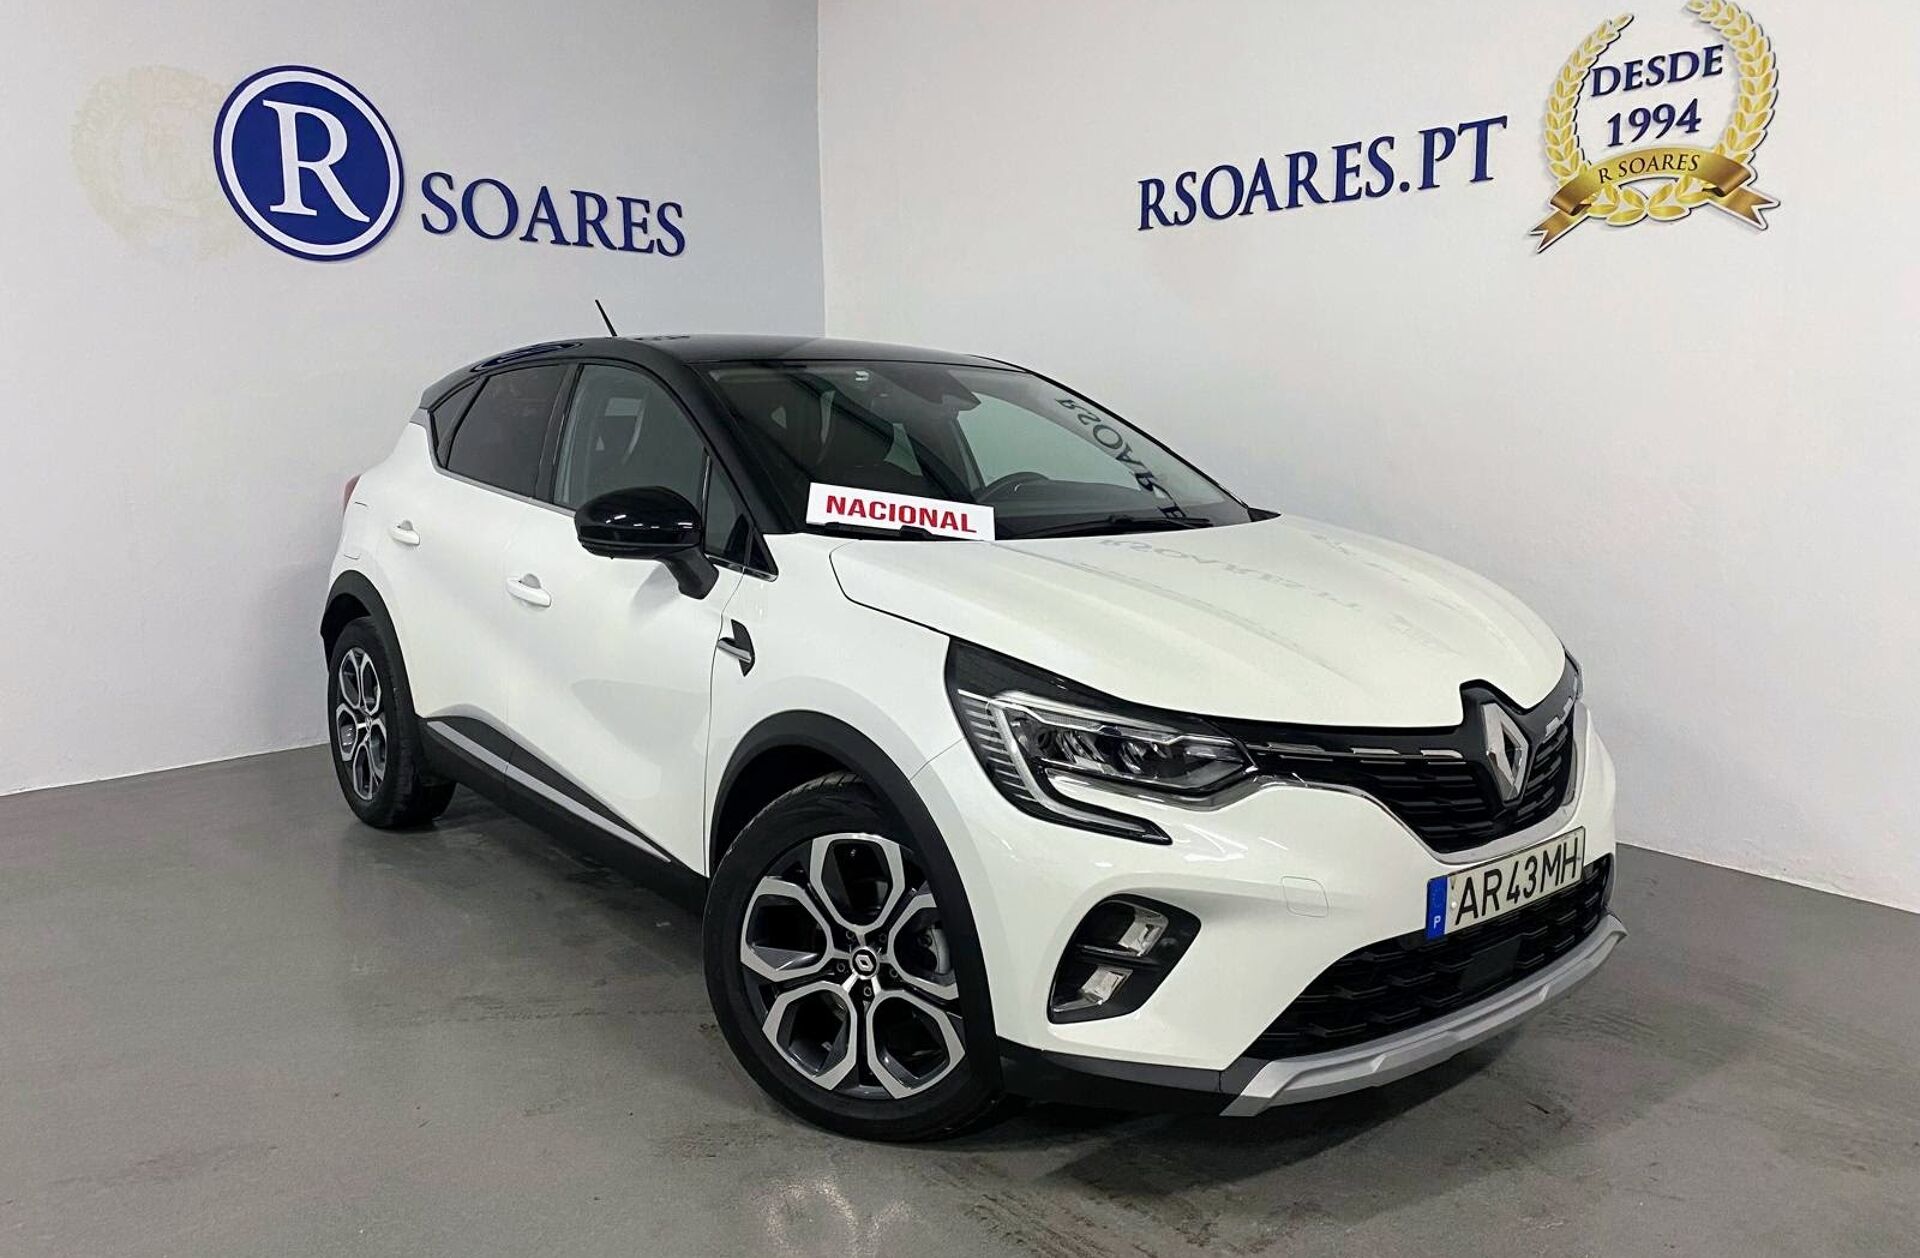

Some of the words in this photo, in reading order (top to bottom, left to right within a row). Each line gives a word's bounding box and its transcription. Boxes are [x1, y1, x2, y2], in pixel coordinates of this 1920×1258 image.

[1591, 44, 1724, 97] DESDE
[1607, 98, 1702, 147] 1994
[262, 99, 370, 223] R
[420, 171, 686, 257] SOARES
[1137, 115, 1508, 231] RSOARES.PT
[1598, 167, 1612, 184] R
[1618, 154, 1700, 178] SOARES
[826, 495, 977, 534] NACIONAL
[1433, 915, 1441, 929] P
